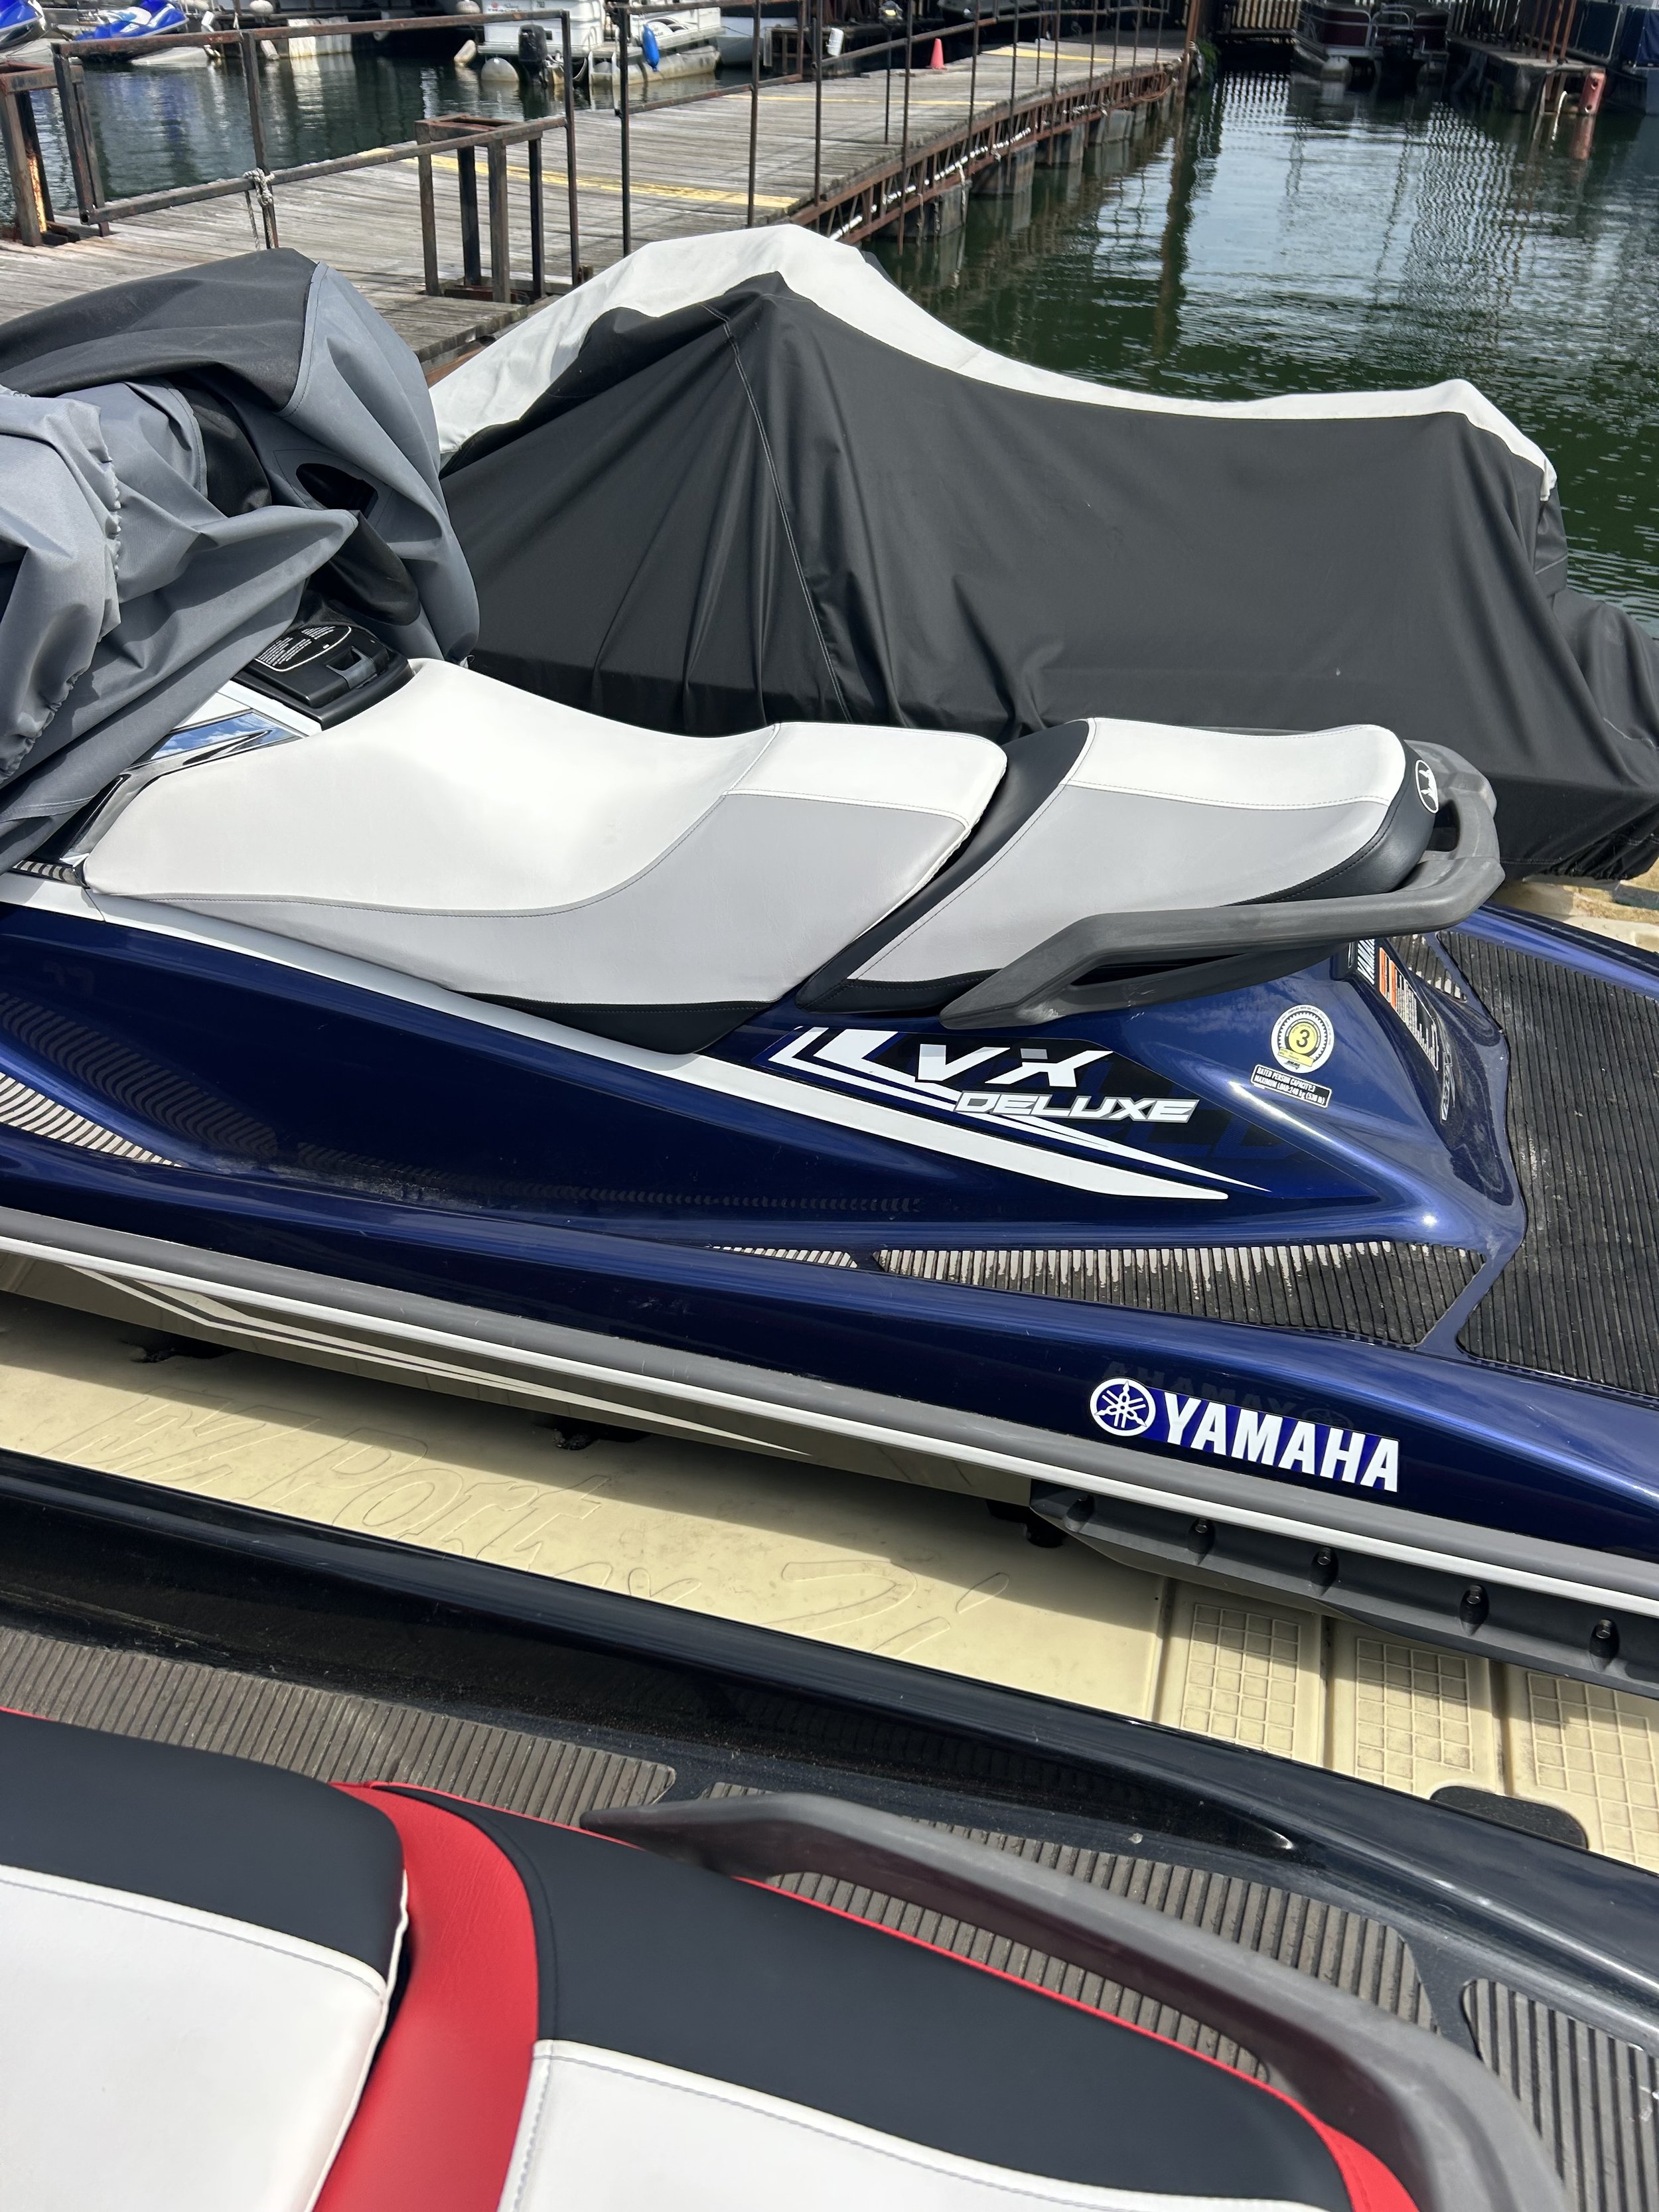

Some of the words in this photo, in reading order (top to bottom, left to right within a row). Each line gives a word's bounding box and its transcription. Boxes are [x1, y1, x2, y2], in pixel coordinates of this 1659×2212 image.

[1356, 938, 1375, 986] YAMA
[1296, 1029, 1310, 1048] 3
[916, 1043, 1114, 1088] VX
[1254, 1074, 1278, 1088] MAXIMUM
[1256, 1067, 1273, 1078] RATED
[1271, 1072, 1291, 1084] PERSON
[953, 1090, 1200, 1123] DELUXE
[1164, 1391, 1399, 1493] YAMAHA
